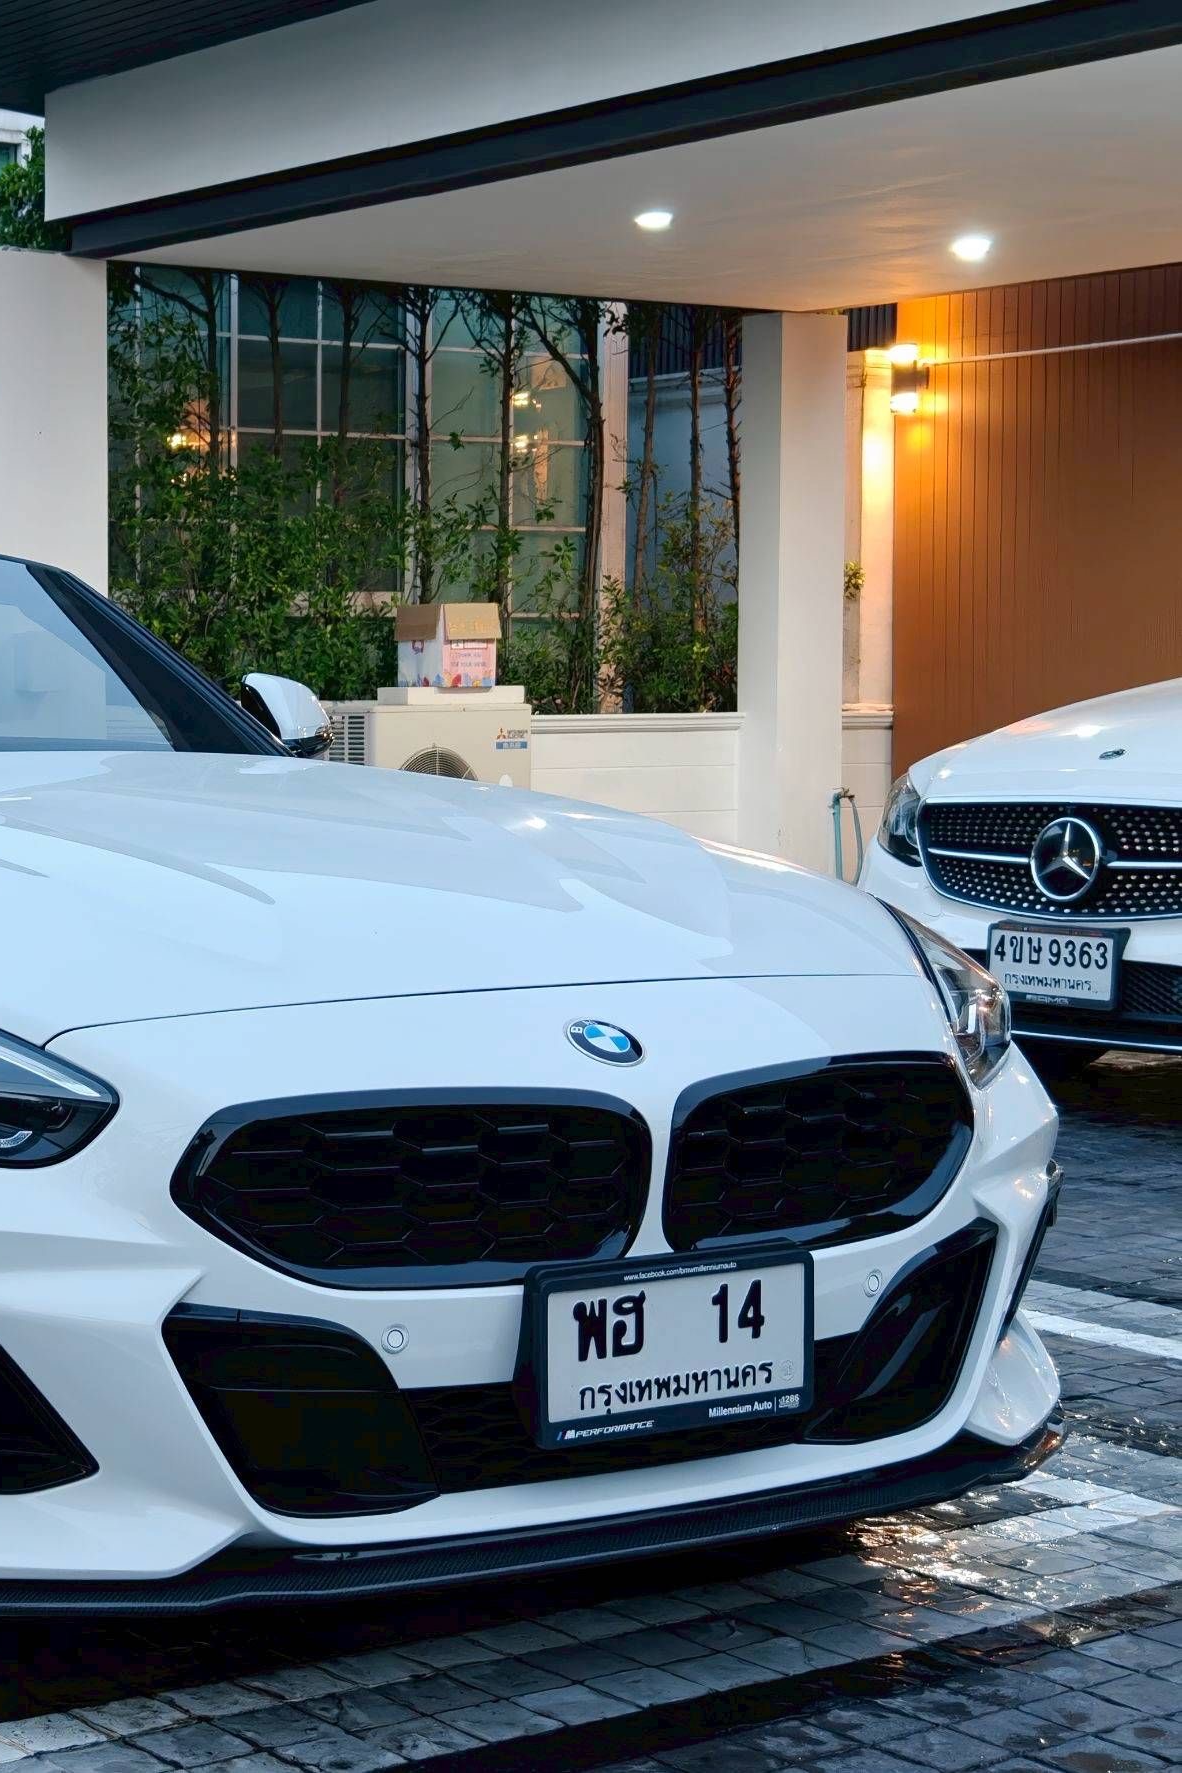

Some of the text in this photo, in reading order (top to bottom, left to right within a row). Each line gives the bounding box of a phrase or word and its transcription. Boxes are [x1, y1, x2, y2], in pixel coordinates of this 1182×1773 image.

[1048, 938, 1109, 970] 9363
[1004, 971, 1093, 991] กรุงเทพมหานคร
[711, 1279, 765, 1343] 14
[579, 1361, 774, 1414] กรุงเทพมหานคร
[708, 1403, 752, 1418] Millennium
[753, 1400, 773, 1412] Auto
[575, 1419, 655, 1439] PERFORMANCE
